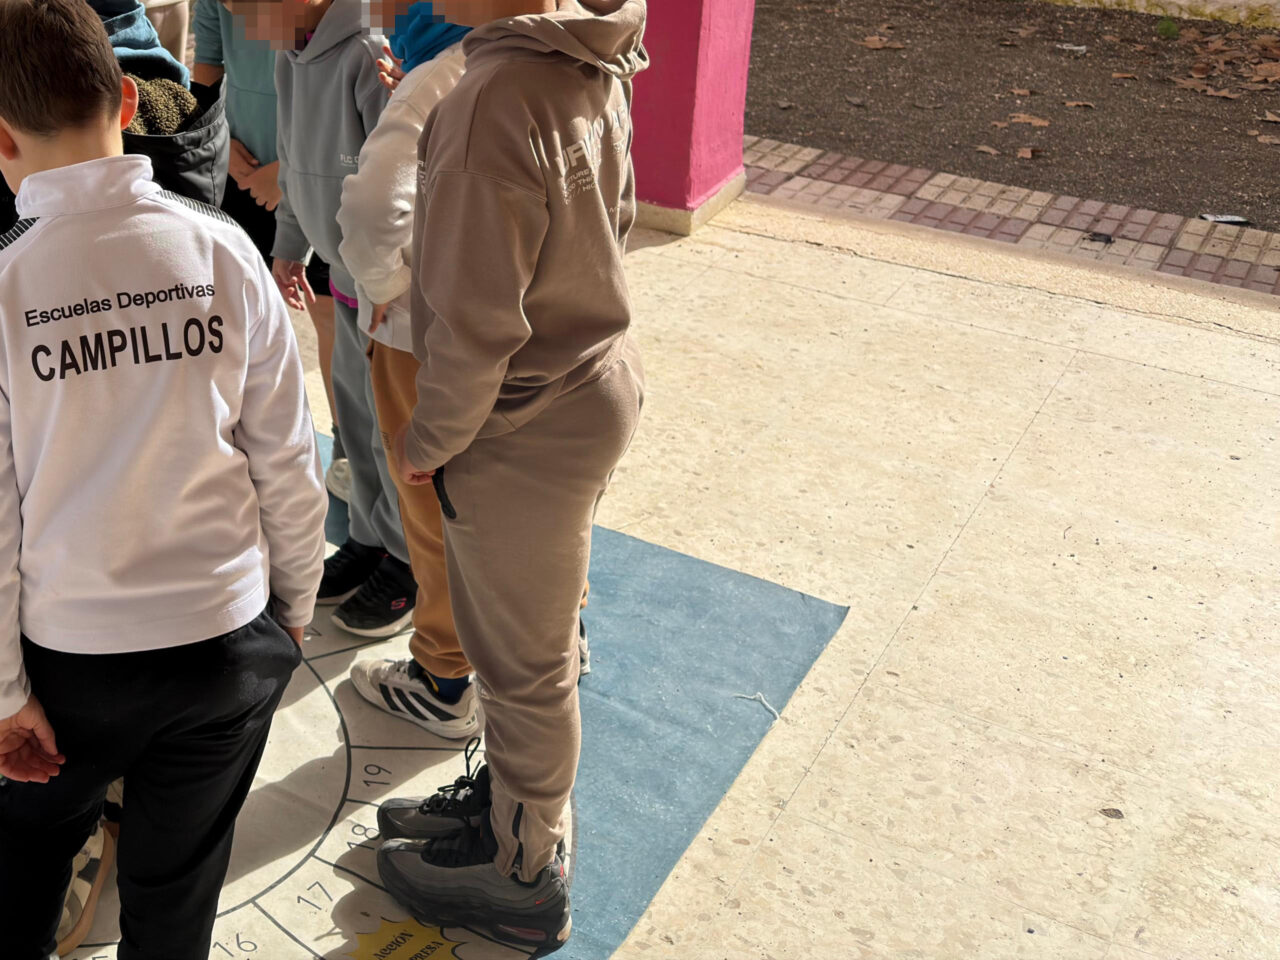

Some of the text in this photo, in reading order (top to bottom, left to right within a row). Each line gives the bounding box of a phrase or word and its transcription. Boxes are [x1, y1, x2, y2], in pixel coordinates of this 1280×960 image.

[25, 282, 215, 327] Escuelas Deportivas
[32, 314, 224, 381] CAMPILLOS
[362, 763, 392, 787] 19
[346, 823, 381, 850] 18
[297, 881, 333, 910] 17
[212, 932, 258, 958] 16
[409, 941, 444, 960] PRESA
